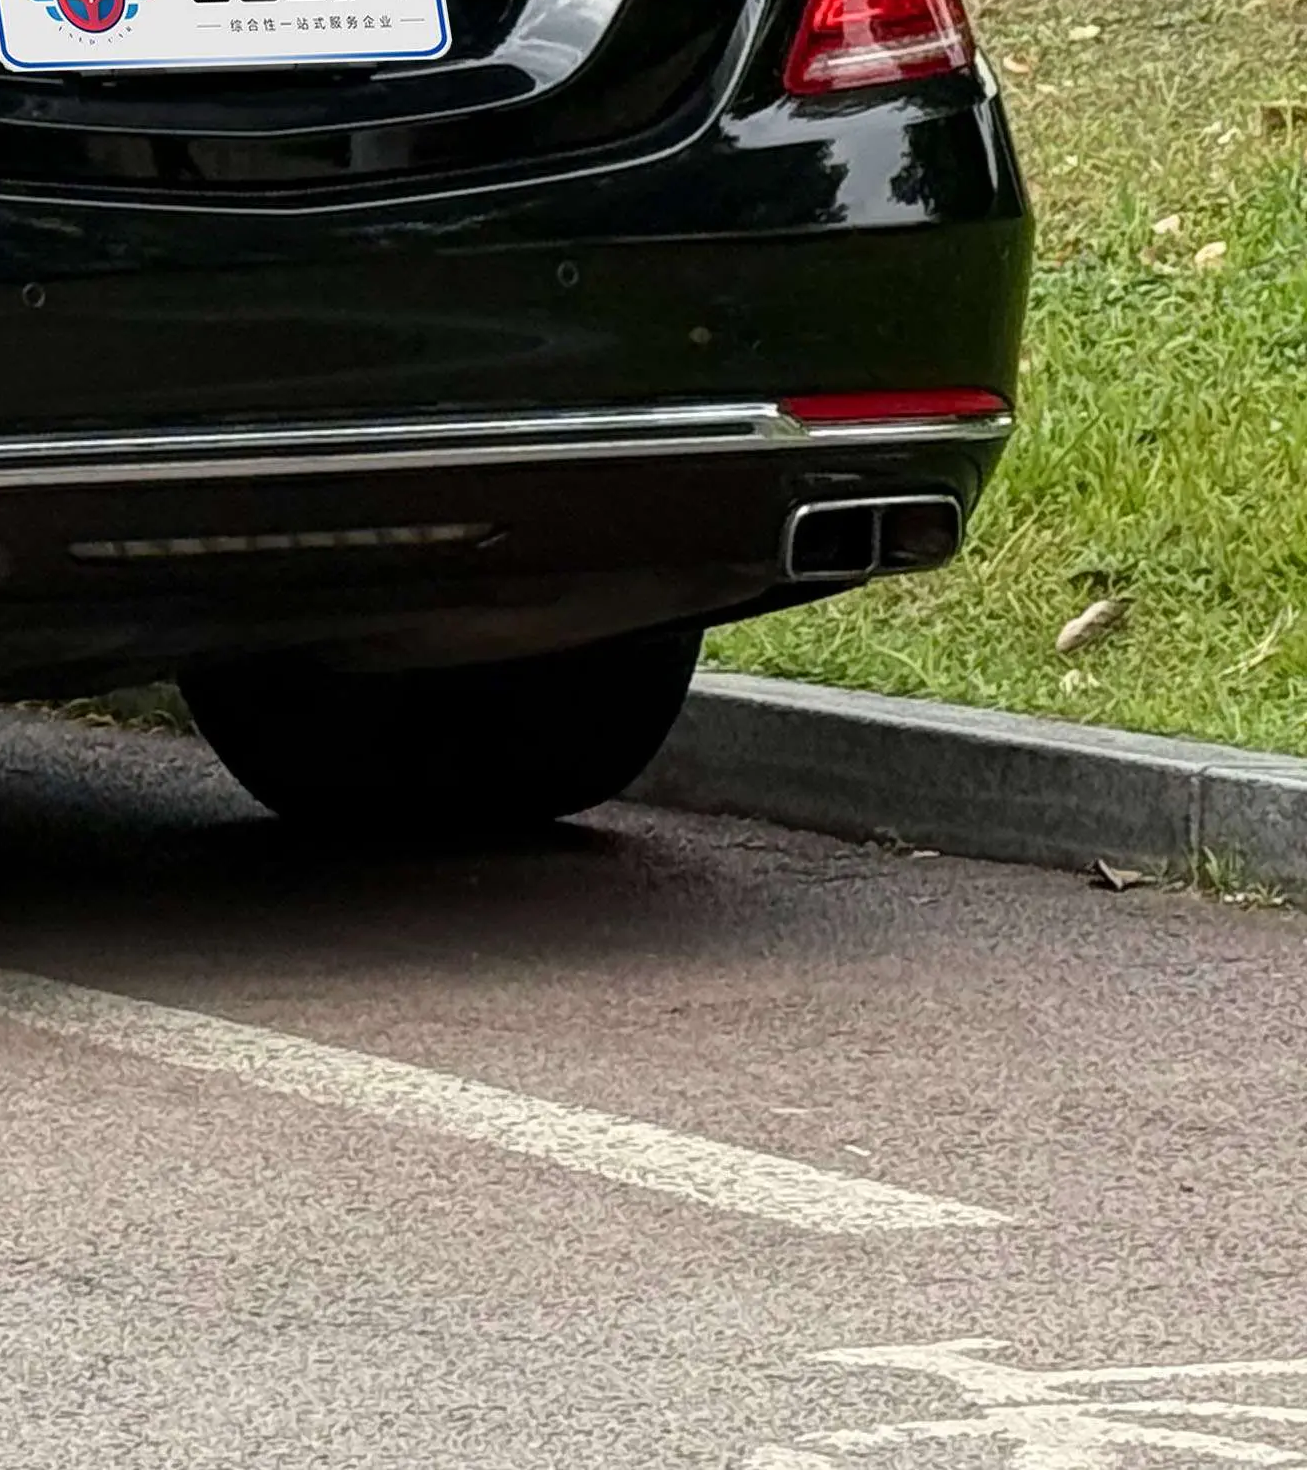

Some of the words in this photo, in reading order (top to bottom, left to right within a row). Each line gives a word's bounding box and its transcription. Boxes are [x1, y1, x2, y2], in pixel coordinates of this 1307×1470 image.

[229, 14, 393, 33] 综合性一站式服务企业
